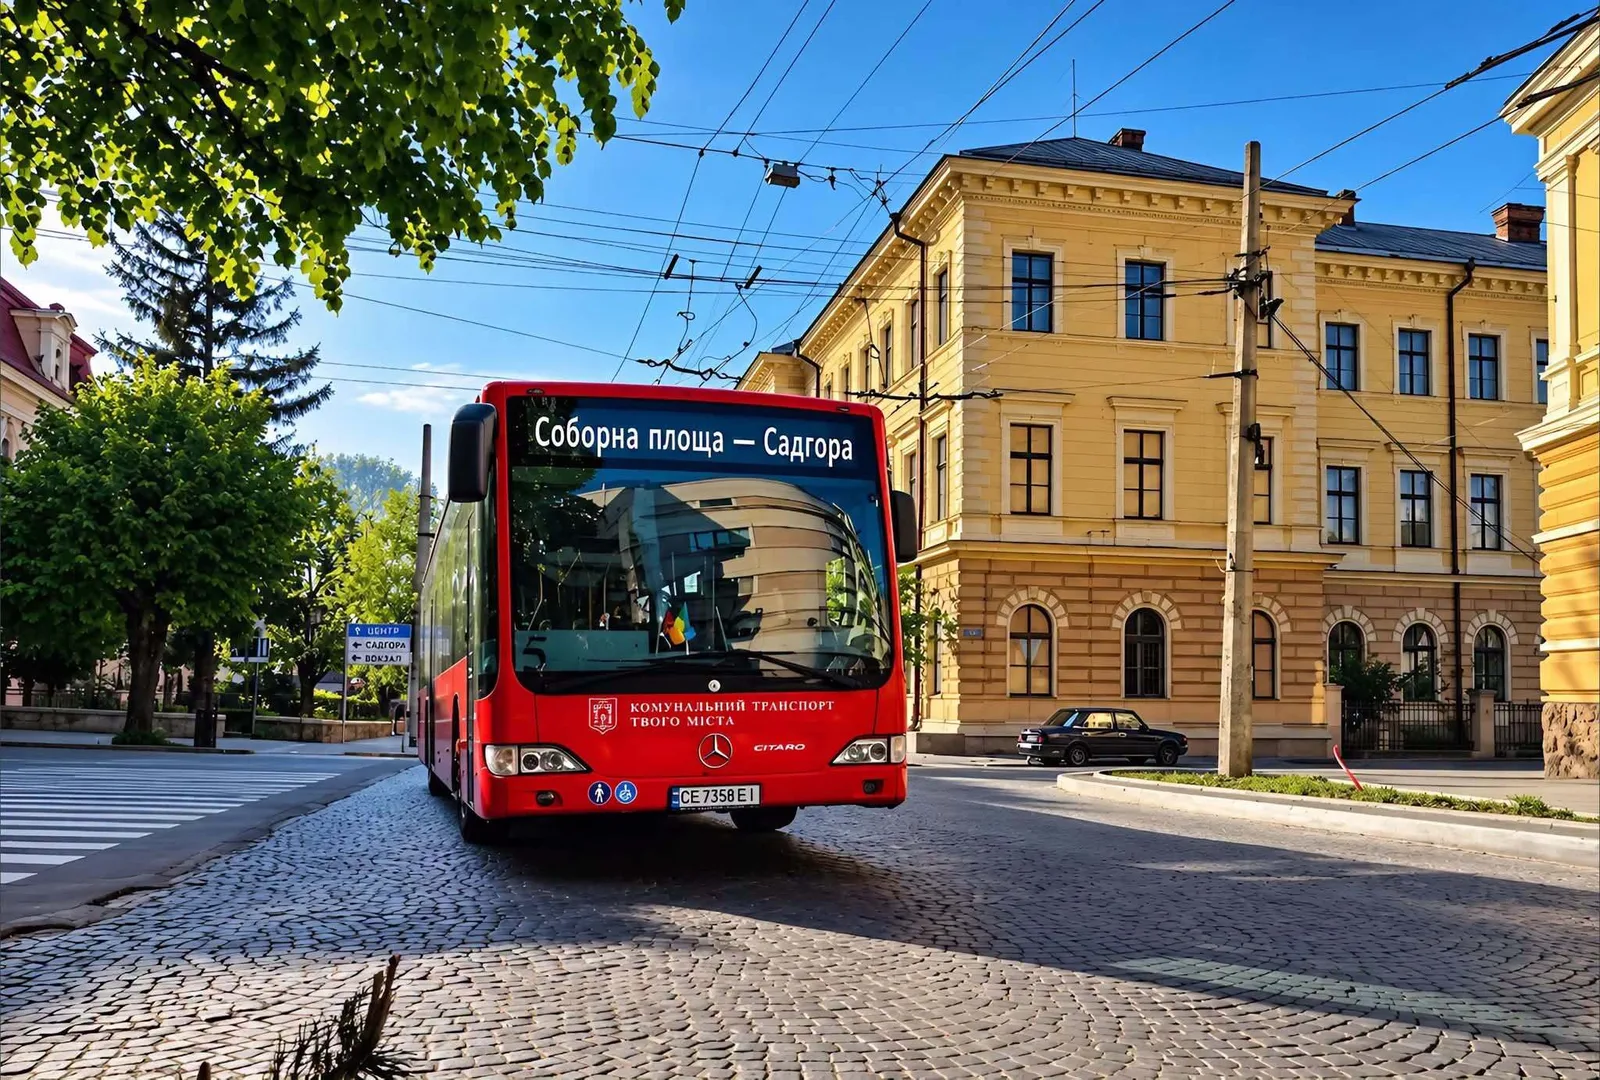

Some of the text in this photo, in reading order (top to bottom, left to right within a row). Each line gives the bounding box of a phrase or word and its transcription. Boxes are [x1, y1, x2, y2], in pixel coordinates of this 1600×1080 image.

[535, 416, 638, 457] Соборна
[649, 428, 724, 458] площа
[764, 427, 853, 467] Садгора
[367, 627, 400, 635] ЦЕНТР
[365, 641, 406, 649] САДГОРА
[630, 700, 834, 713] КОМУНАЛЬНИЙ ТРАНСПОРТ
[630, 716, 734, 727] ТВОГО МІСТА
[754, 744, 806, 752] CITARO
